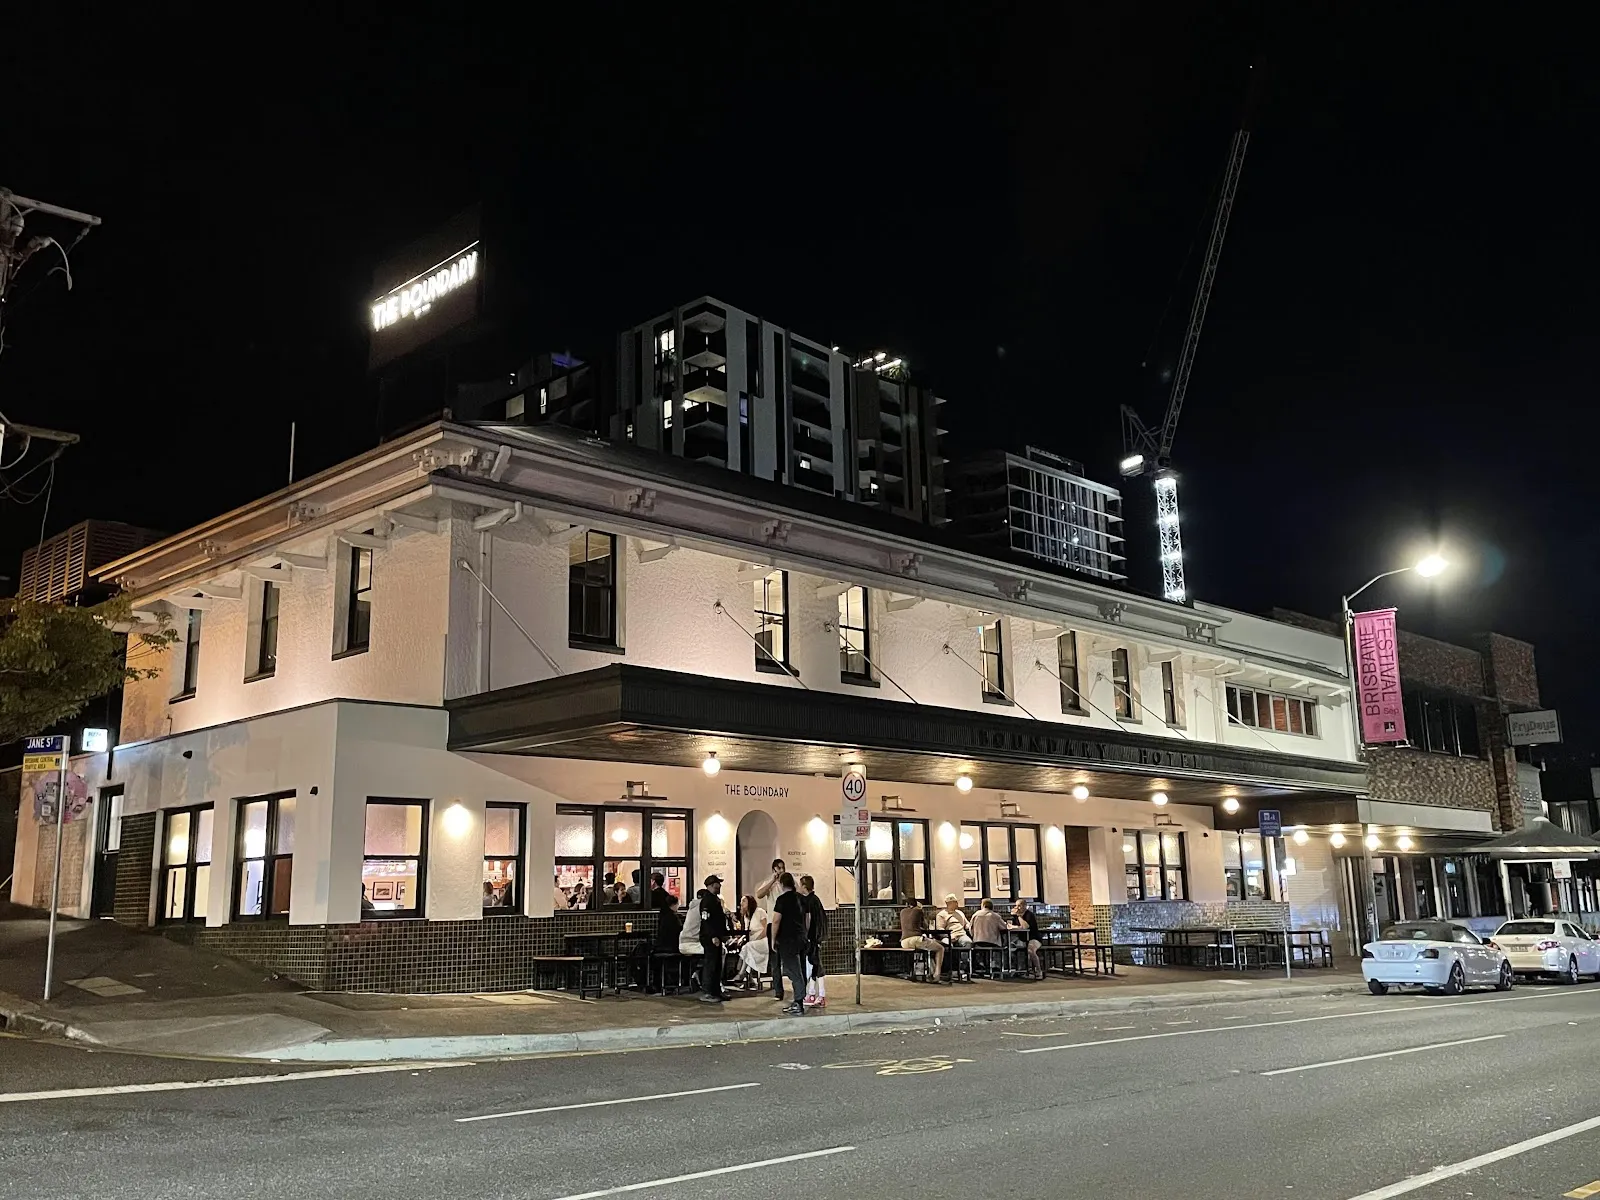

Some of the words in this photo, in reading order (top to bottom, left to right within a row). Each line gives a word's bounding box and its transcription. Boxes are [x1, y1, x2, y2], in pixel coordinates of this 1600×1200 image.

[372, 296, 398, 332] THE
[401, 250, 478, 319] BOUNDARY
[1359, 618, 1381, 716] BRISBANE
[1376, 617, 1398, 703] FESTIVAL
[1384, 707, 1399, 715] Sep
[27, 738, 45, 749] JANE
[1139, 749, 1203, 769] HOTEL
[725, 783, 741, 796] THE
[744, 785, 789, 798] BOUNDARY
[846, 779, 863, 794] 40
